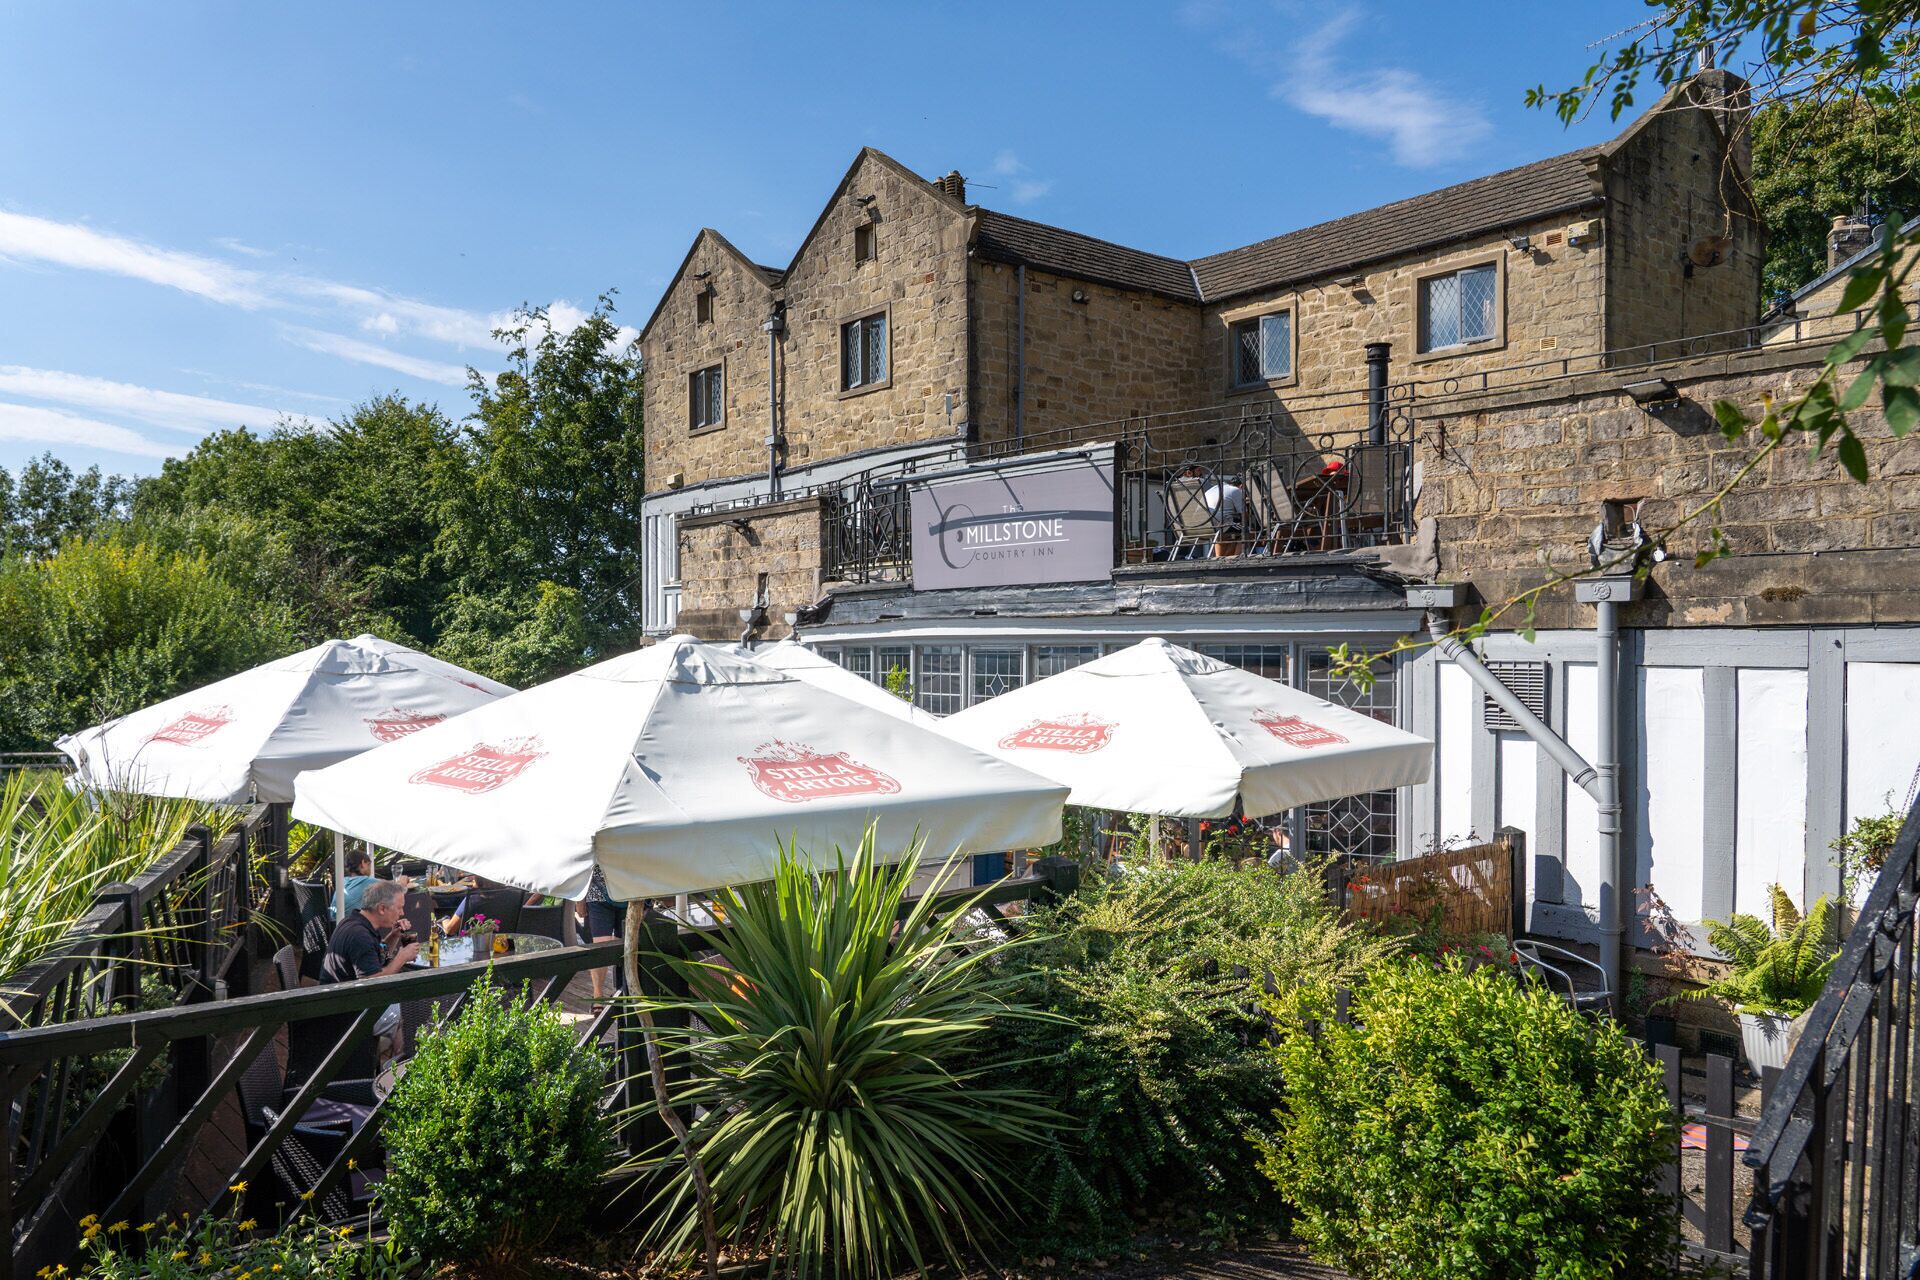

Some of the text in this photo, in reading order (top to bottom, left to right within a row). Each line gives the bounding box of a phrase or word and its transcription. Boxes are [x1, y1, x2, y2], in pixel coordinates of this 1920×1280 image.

[966, 519, 1063, 544] MILLSTONE
[975, 547, 1055, 561] COUNTRY INN
[1019, 735, 1089, 746] ARTOIS
[1036, 727, 1098, 738] STELLA
[457, 755, 521, 772] STELLA
[436, 766, 500, 783] ARTOIS
[766, 764, 856, 780] STELLA
[784, 775, 872, 792] ARTOIS
